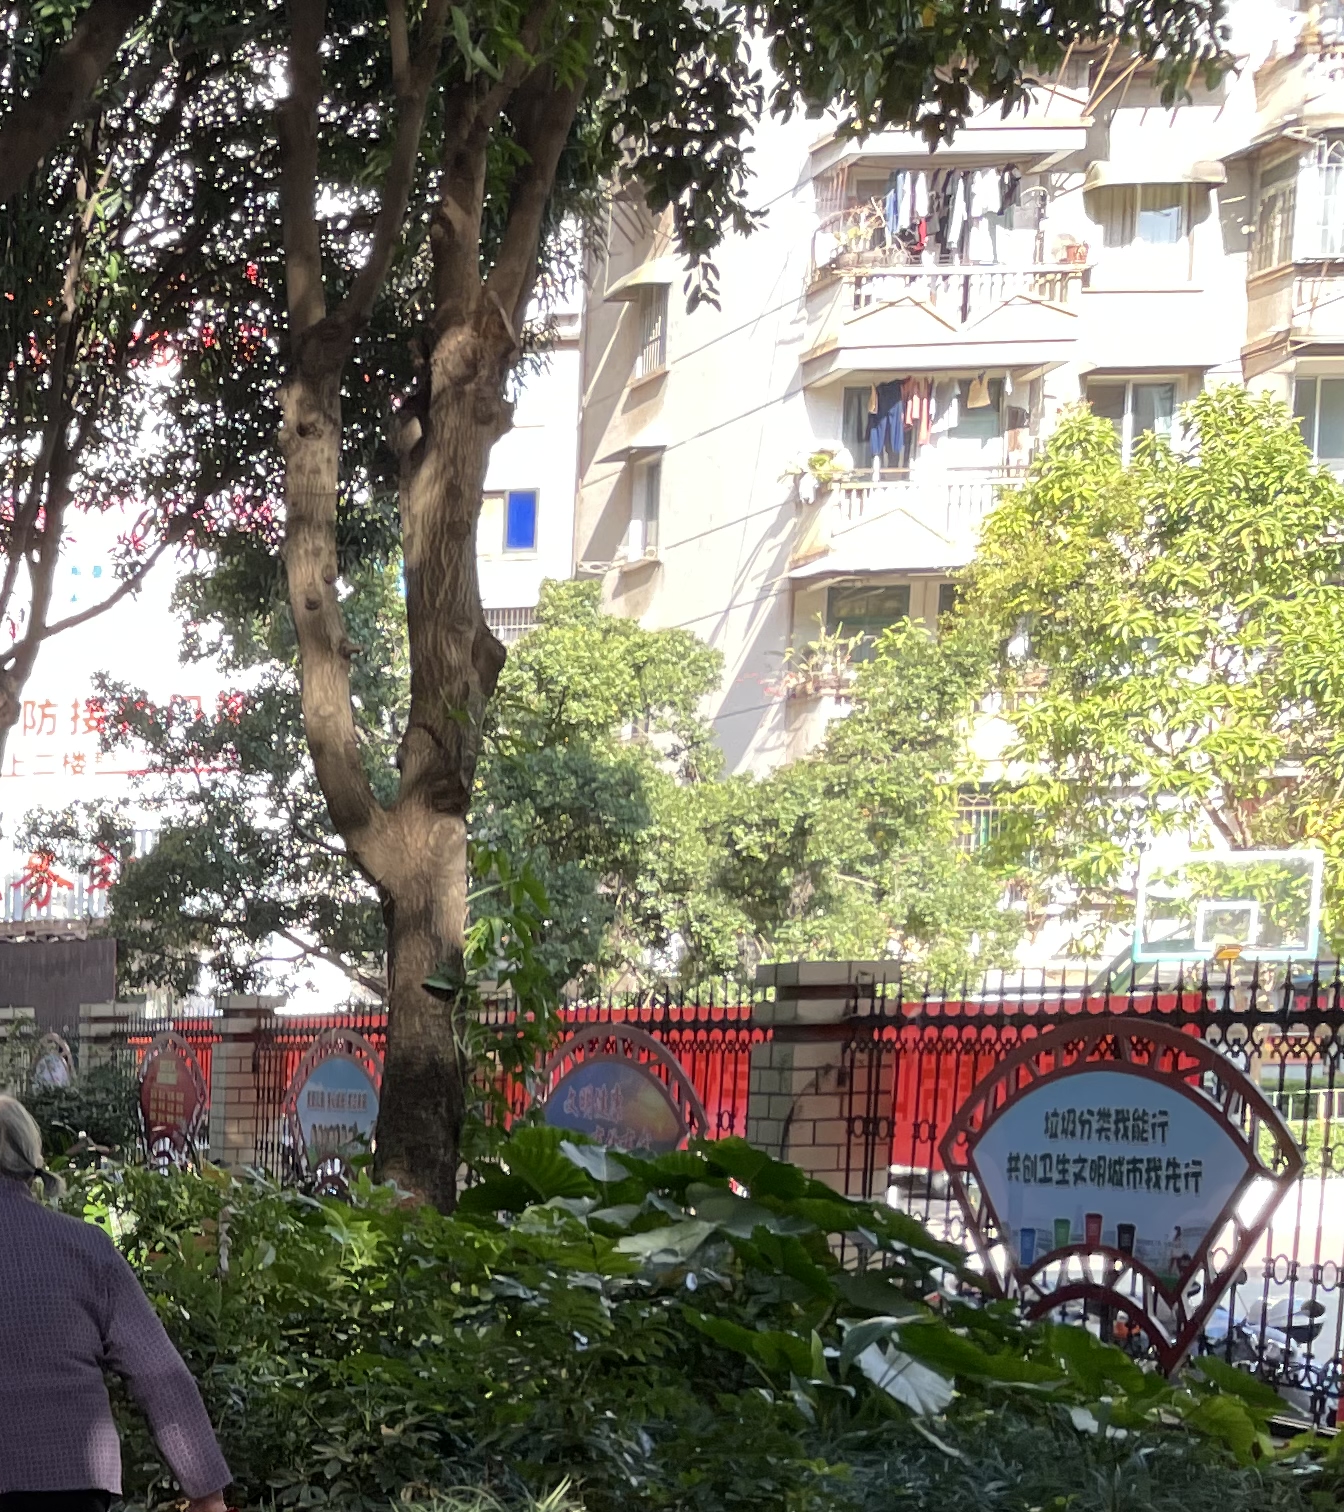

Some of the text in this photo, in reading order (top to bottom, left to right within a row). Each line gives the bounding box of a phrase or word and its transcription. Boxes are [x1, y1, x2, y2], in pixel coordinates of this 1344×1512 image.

[1044, 1107, 1170, 1144] 垃圾分类我能行
[1006, 1152, 1203, 1195] 共创卫生文明城市我先行
